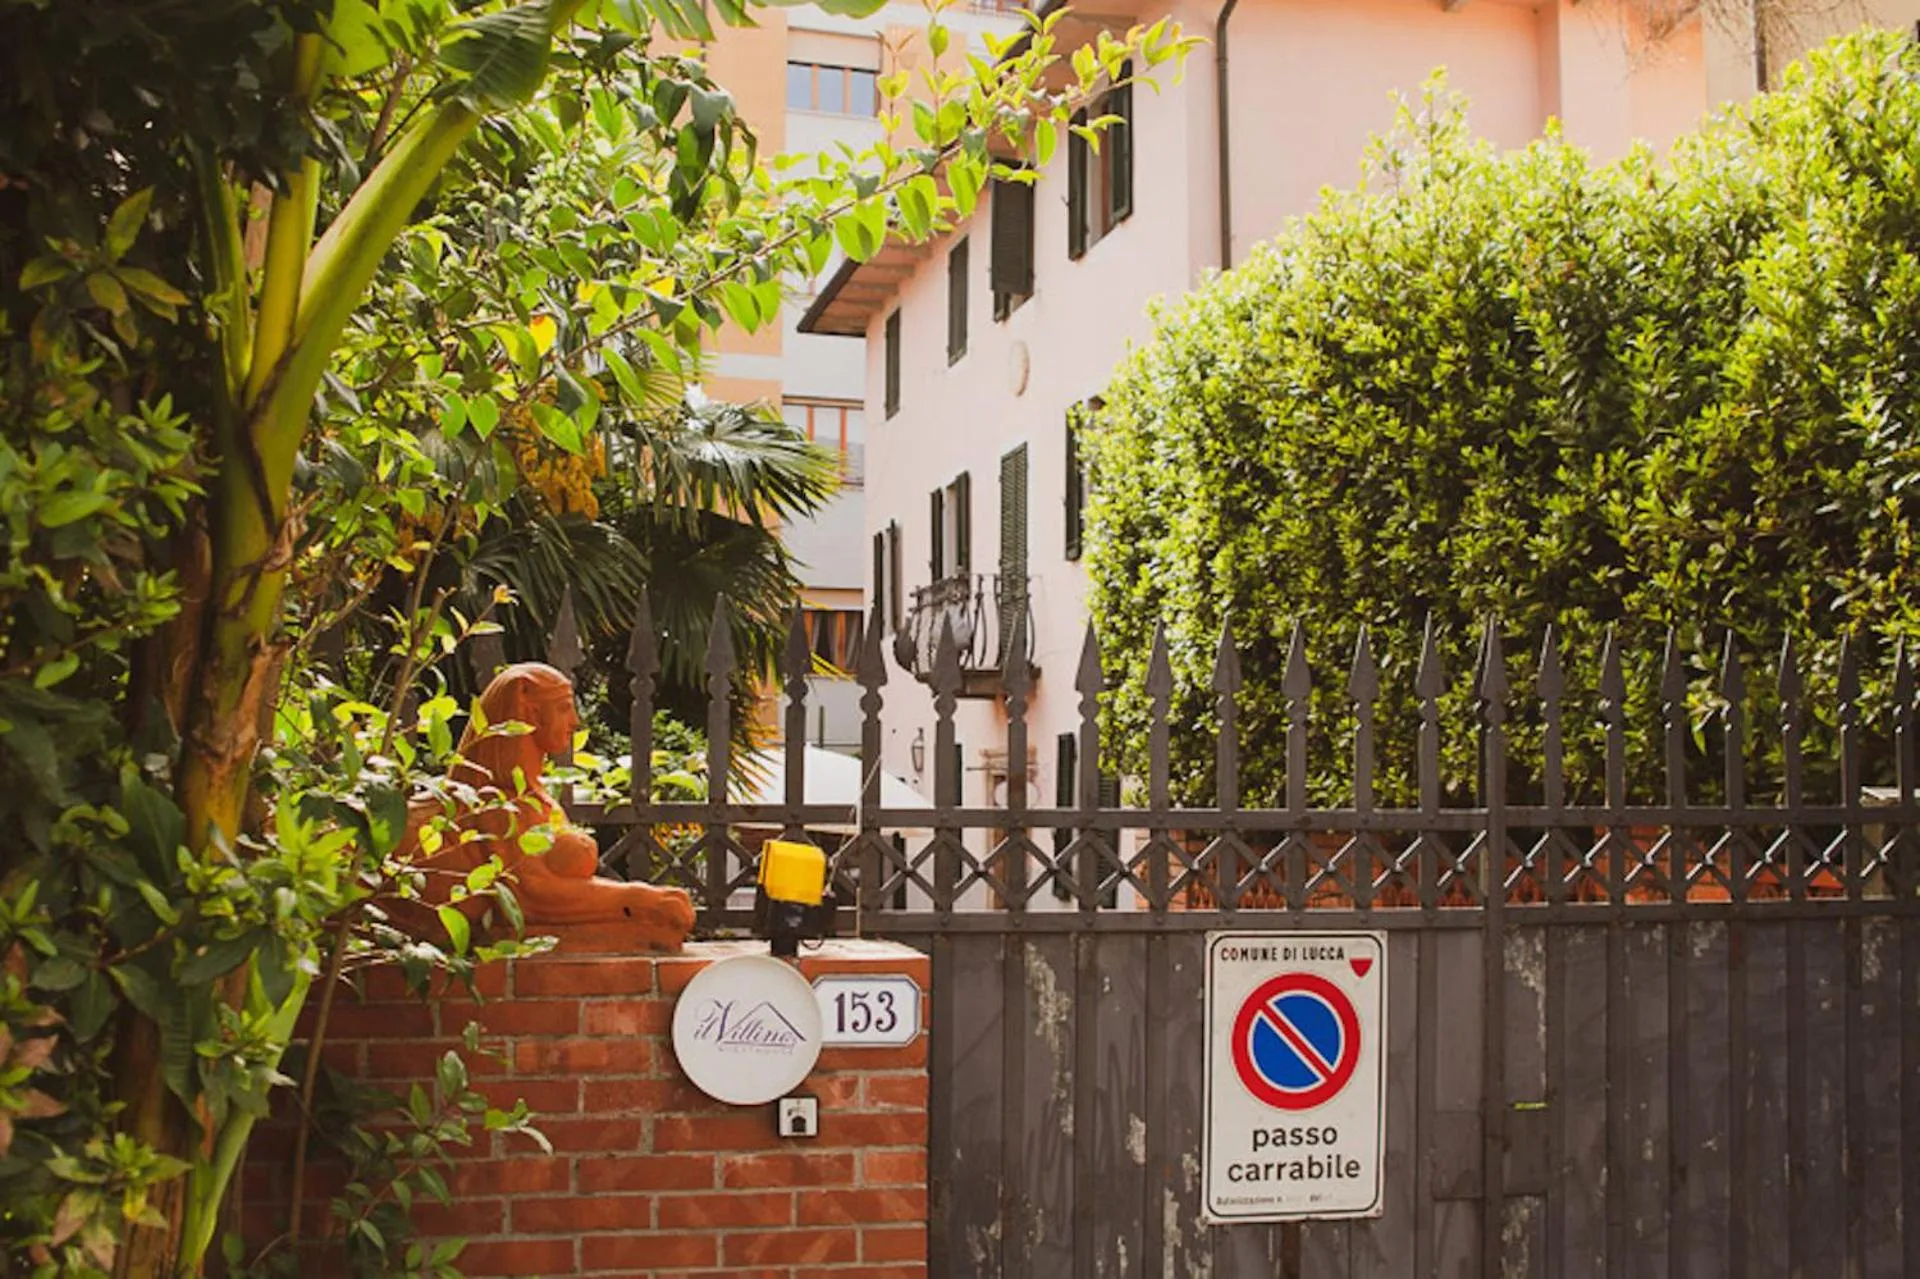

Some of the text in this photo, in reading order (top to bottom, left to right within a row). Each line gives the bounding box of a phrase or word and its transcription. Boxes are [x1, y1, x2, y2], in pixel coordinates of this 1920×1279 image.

[1220, 945, 1346, 961] COMUNE DI LUCCA
[834, 990, 897, 1034] 153
[1252, 1126, 1338, 1152] passo
[1228, 1154, 1361, 1182] carrabile
